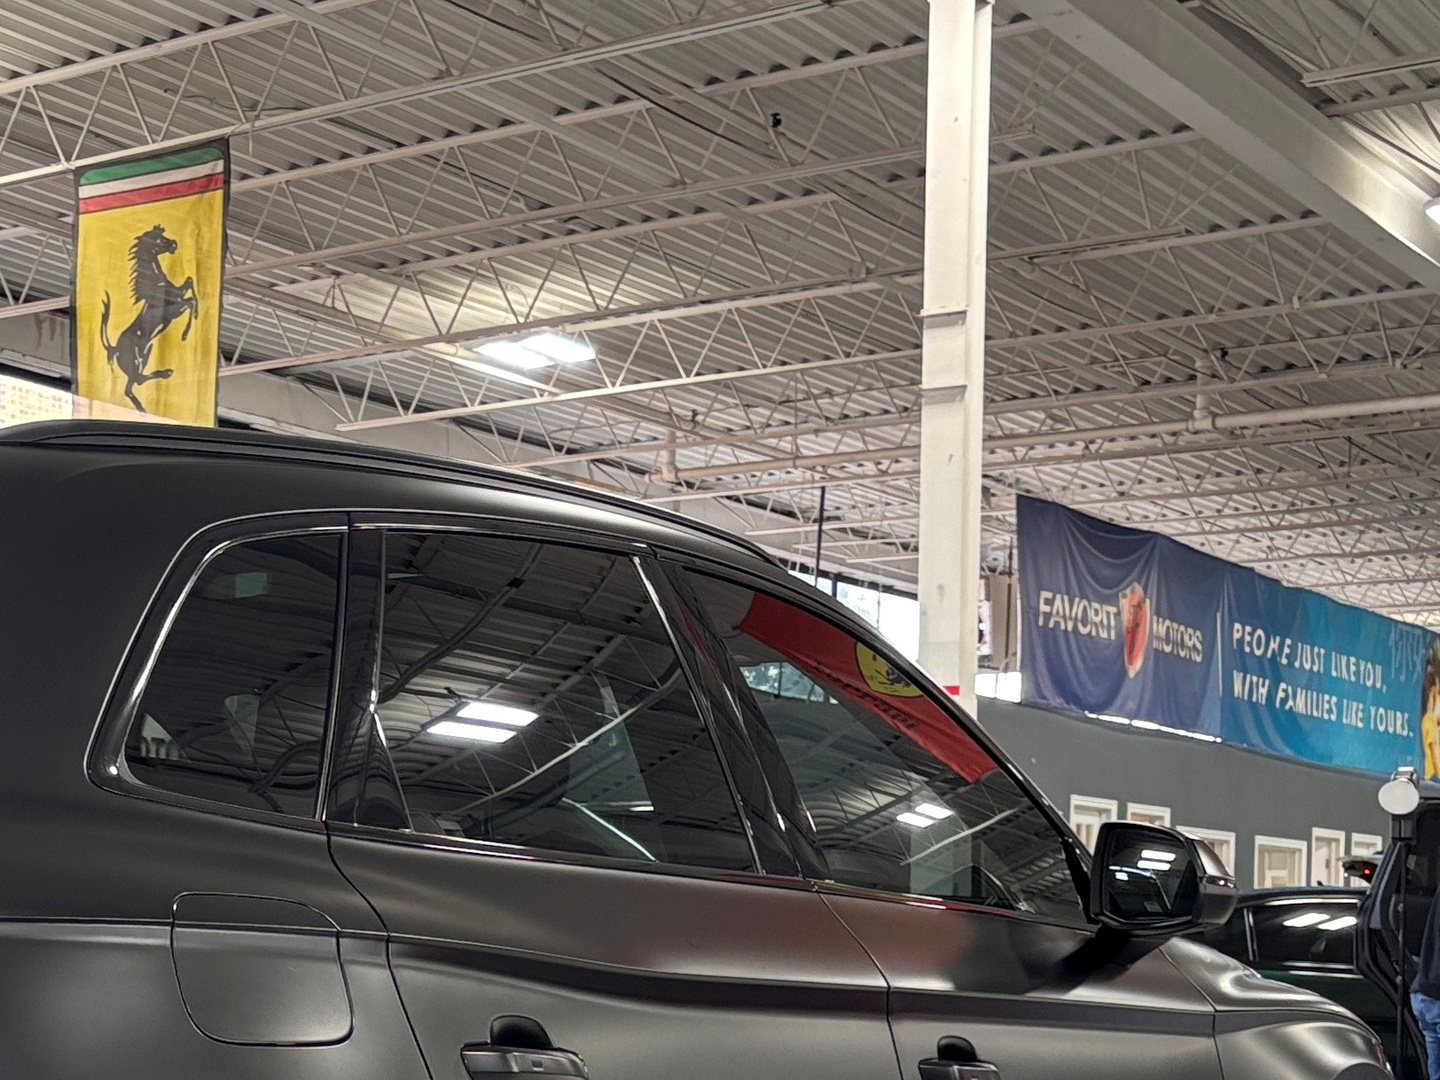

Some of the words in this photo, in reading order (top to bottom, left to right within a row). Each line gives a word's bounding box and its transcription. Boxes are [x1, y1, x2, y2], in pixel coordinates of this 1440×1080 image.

[1038, 590, 1118, 641] FAVORIT
[1152, 615, 1203, 663] MOTORS
[1294, 642, 1326, 674] JUST
[1331, 651, 1357, 682] LIKE
[1233, 669, 1270, 705] WITH
[1276, 682, 1338, 722] FAMILIES
[1342, 699, 1364, 728] LIKE
[1370, 705, 1414, 737] YOURS.
